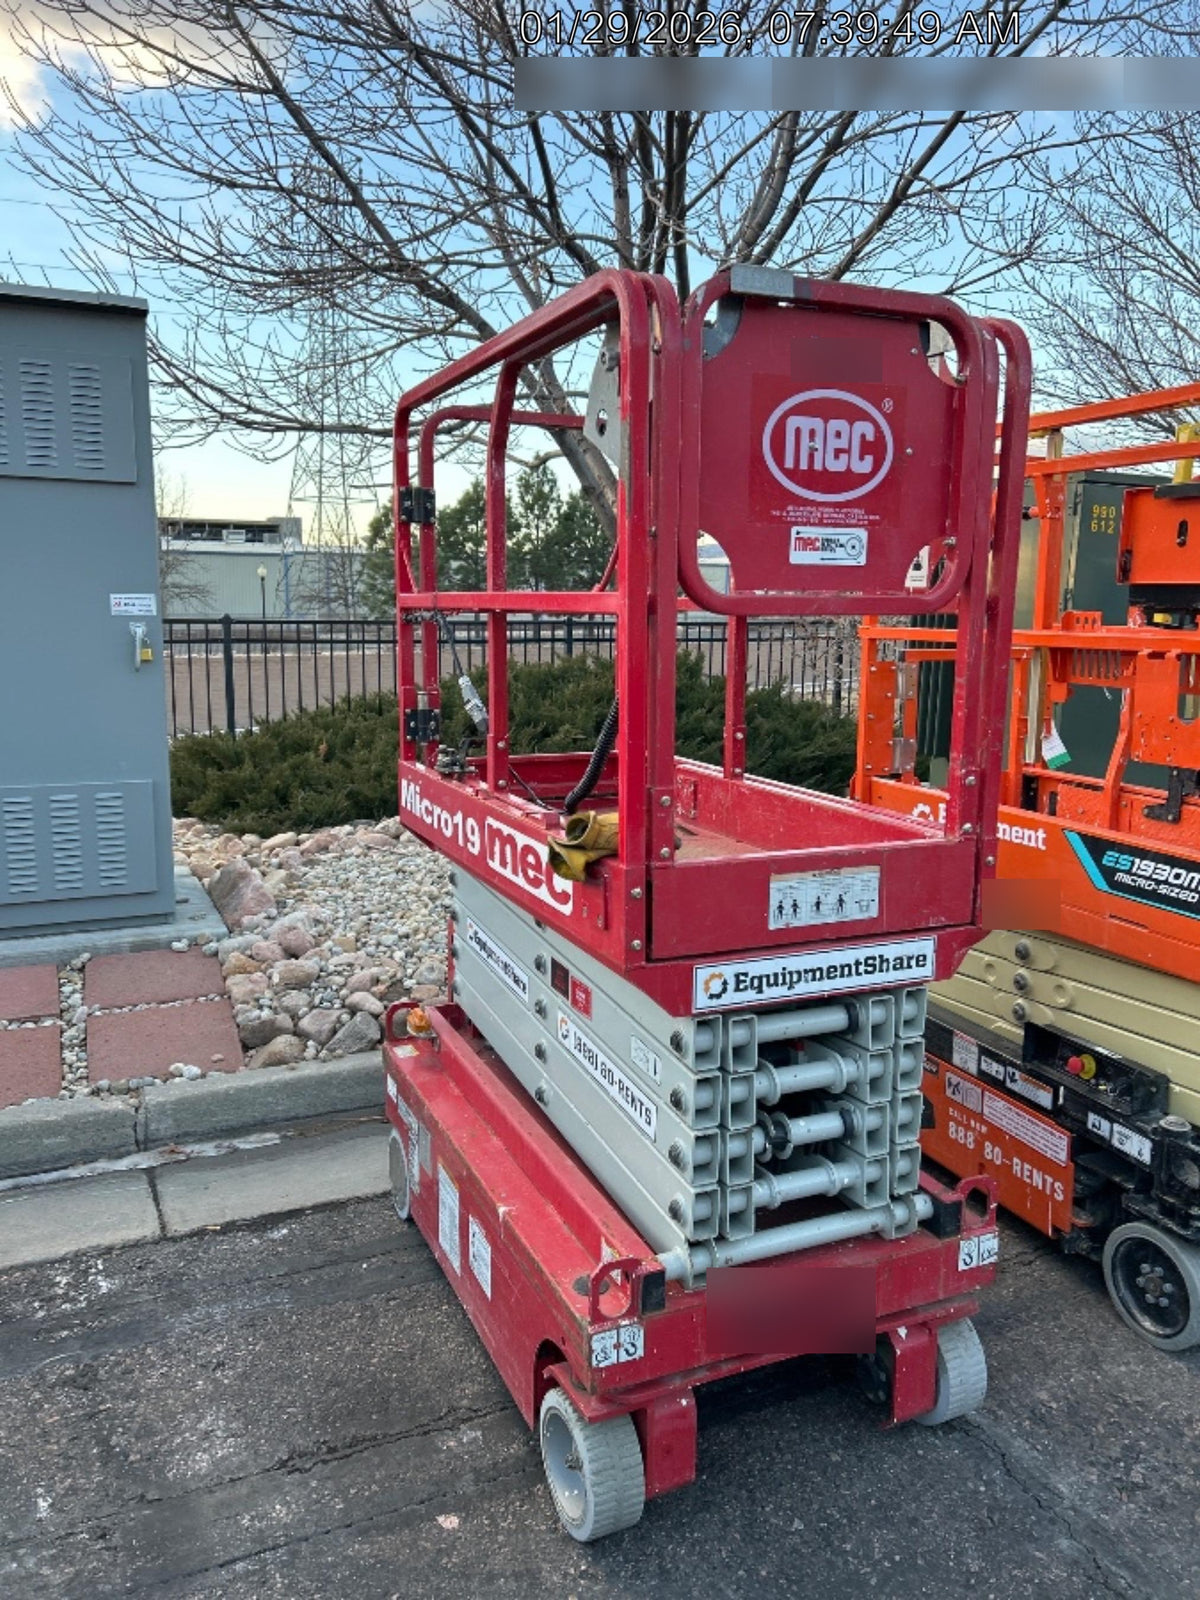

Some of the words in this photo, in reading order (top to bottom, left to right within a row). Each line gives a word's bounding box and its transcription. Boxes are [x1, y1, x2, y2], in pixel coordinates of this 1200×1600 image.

[1090, 518, 1115, 535] 612
[400, 777, 482, 857] Micro19
[732, 953, 928, 995] EquipmentShare
[948, 1120, 976, 1150] 888
[983, 1140, 1065, 1202] 80-RENTS
